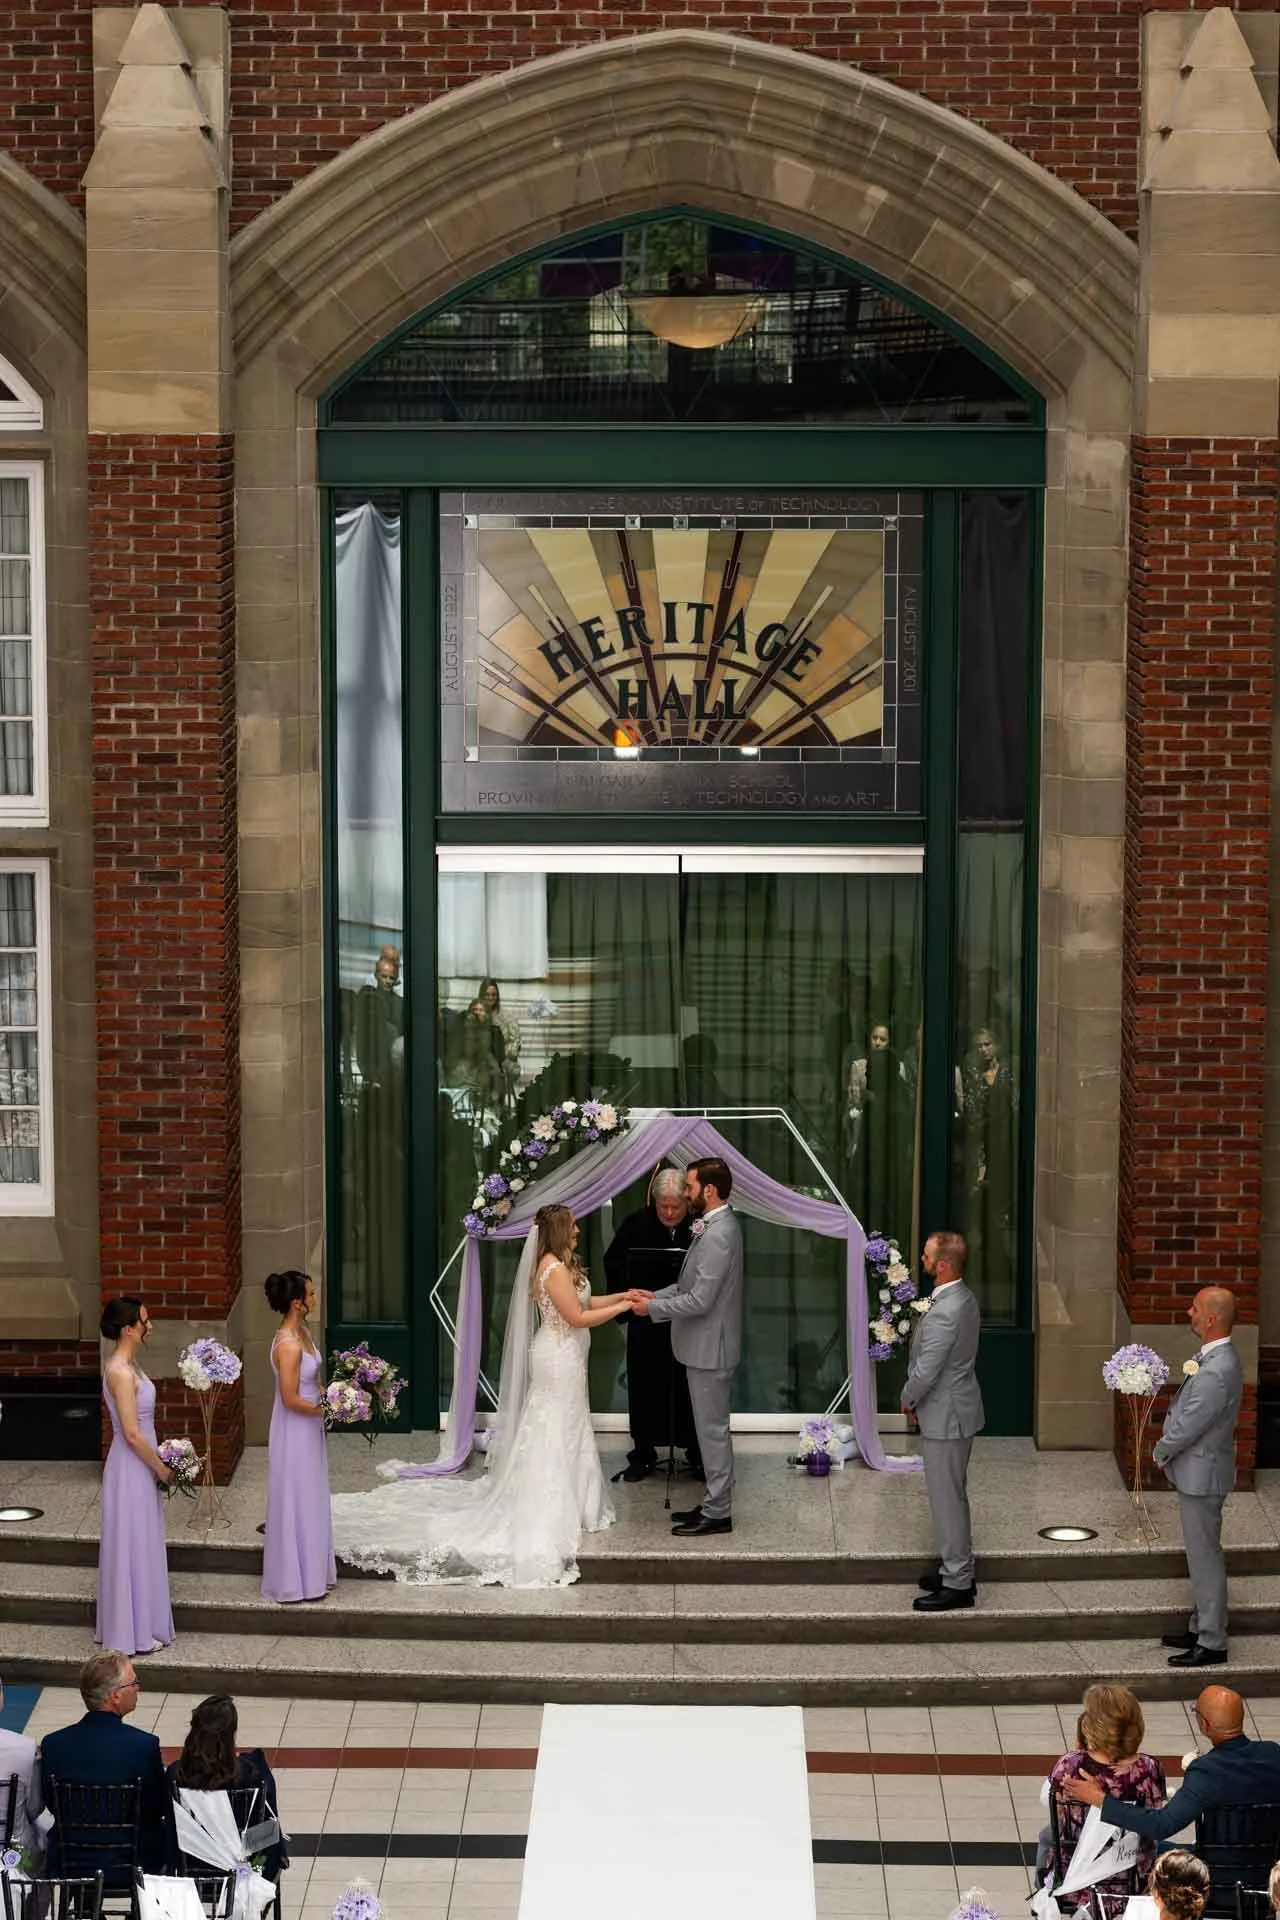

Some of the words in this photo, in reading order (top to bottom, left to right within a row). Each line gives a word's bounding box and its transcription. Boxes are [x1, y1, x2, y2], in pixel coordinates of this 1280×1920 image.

[770, 497, 881, 512] TECHNOLOGY
[536, 600, 823, 683] HERITAGE
[903, 584, 918, 655] AUGUST
[445, 622, 459, 691] AUGUST
[616, 674, 747, 721] HALL
[694, 791, 808, 806] TECHNOLOGY
[845, 791, 881, 806] ART
